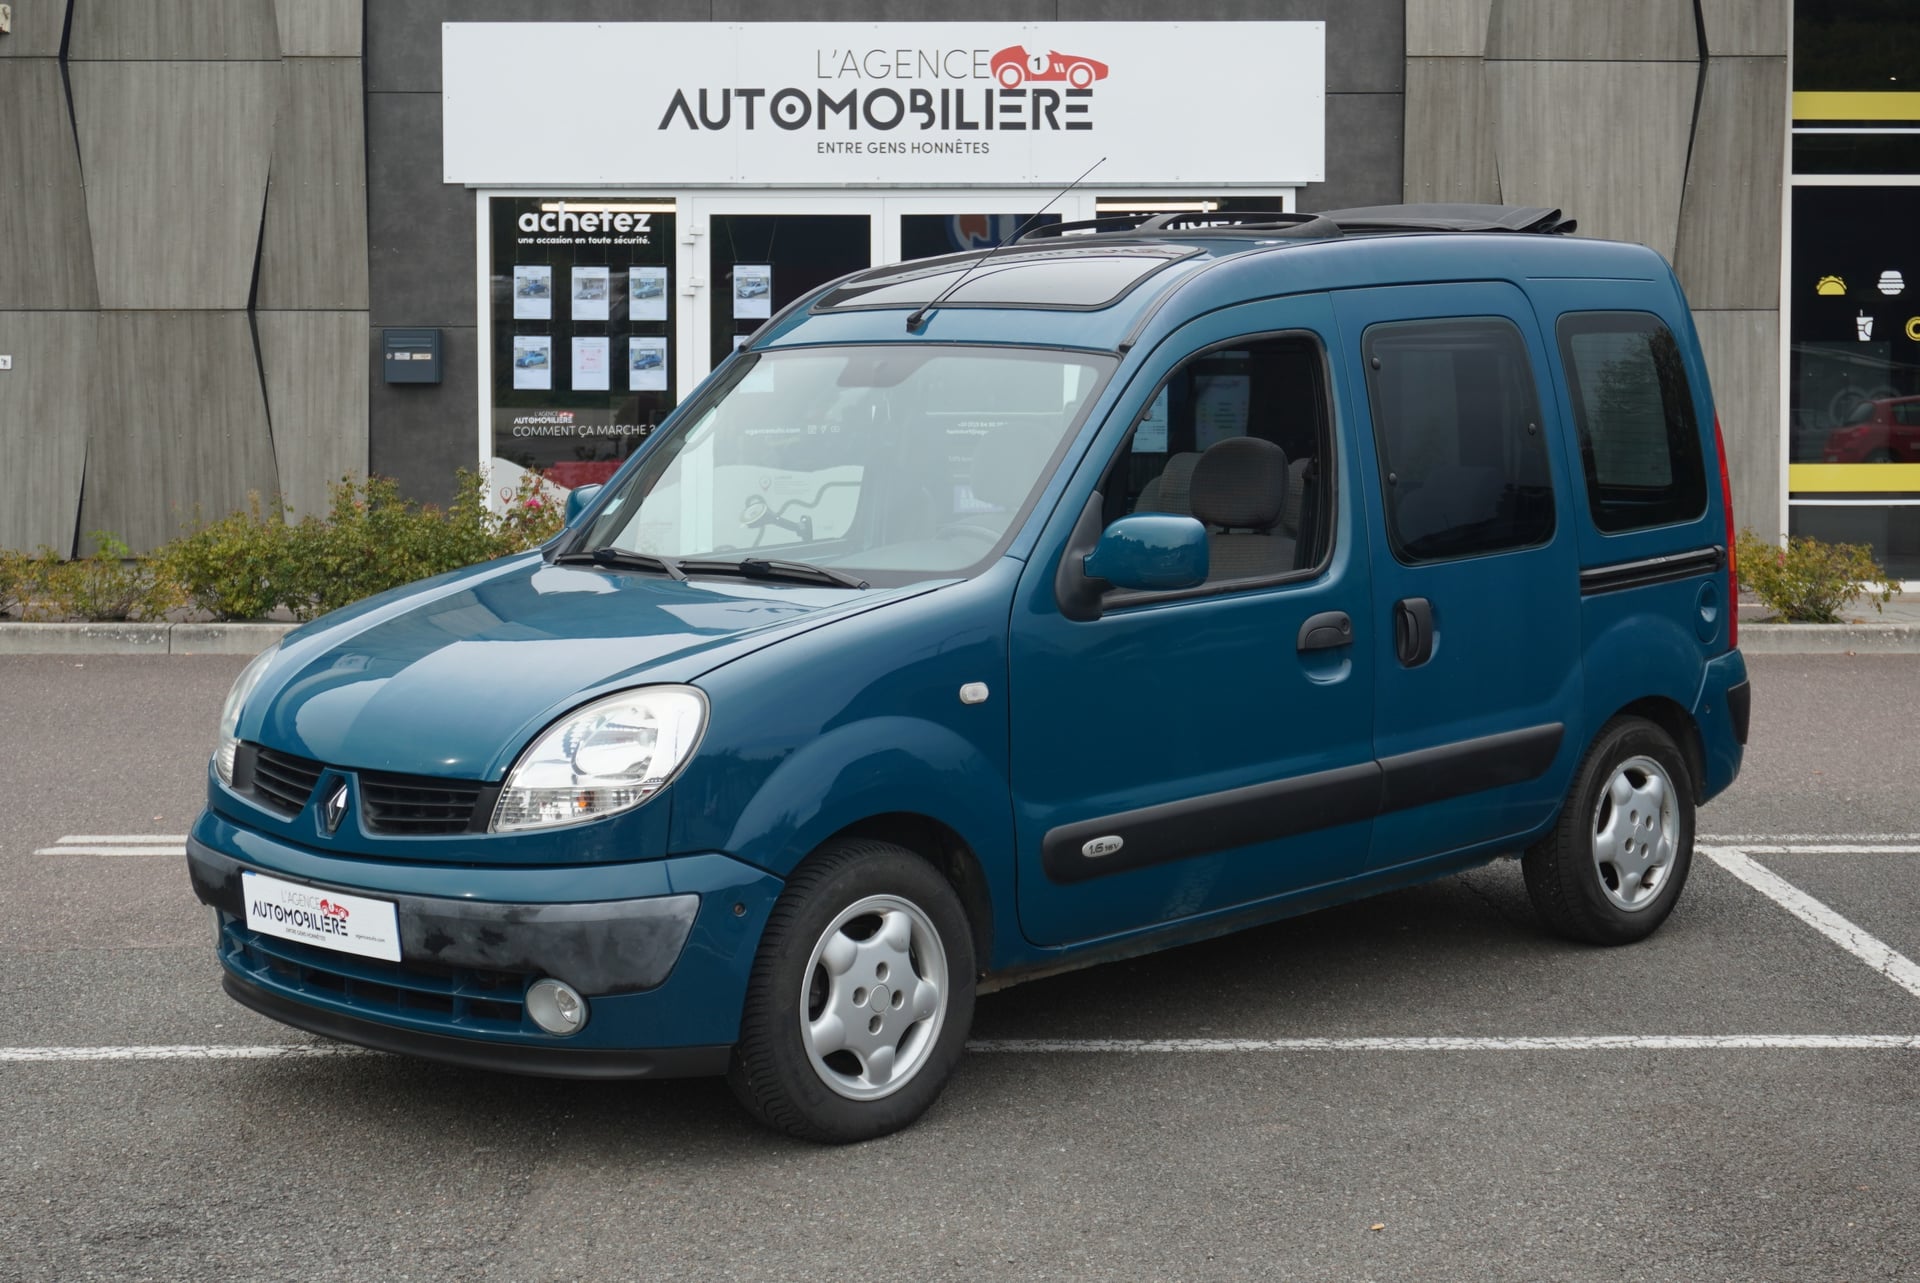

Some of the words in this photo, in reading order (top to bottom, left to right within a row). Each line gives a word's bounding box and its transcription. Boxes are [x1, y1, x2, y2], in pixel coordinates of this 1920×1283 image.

[817, 49, 990, 79] L'AGENCE
[817, 142, 862, 154] ENTRE
[868, 142, 906, 154] GENS
[911, 138, 989, 154] HONNÊTES
[518, 201, 651, 233] achetez
[518, 237, 534, 245] une
[536, 235, 572, 245] occasion
[575, 237, 586, 245] en
[588, 236, 612, 245] toute
[614, 235, 650, 245] sécurité.
[512, 425, 576, 437] COMMENT
[578, 425, 594, 438] ÇA
[597, 424, 646, 436] MARCHE
